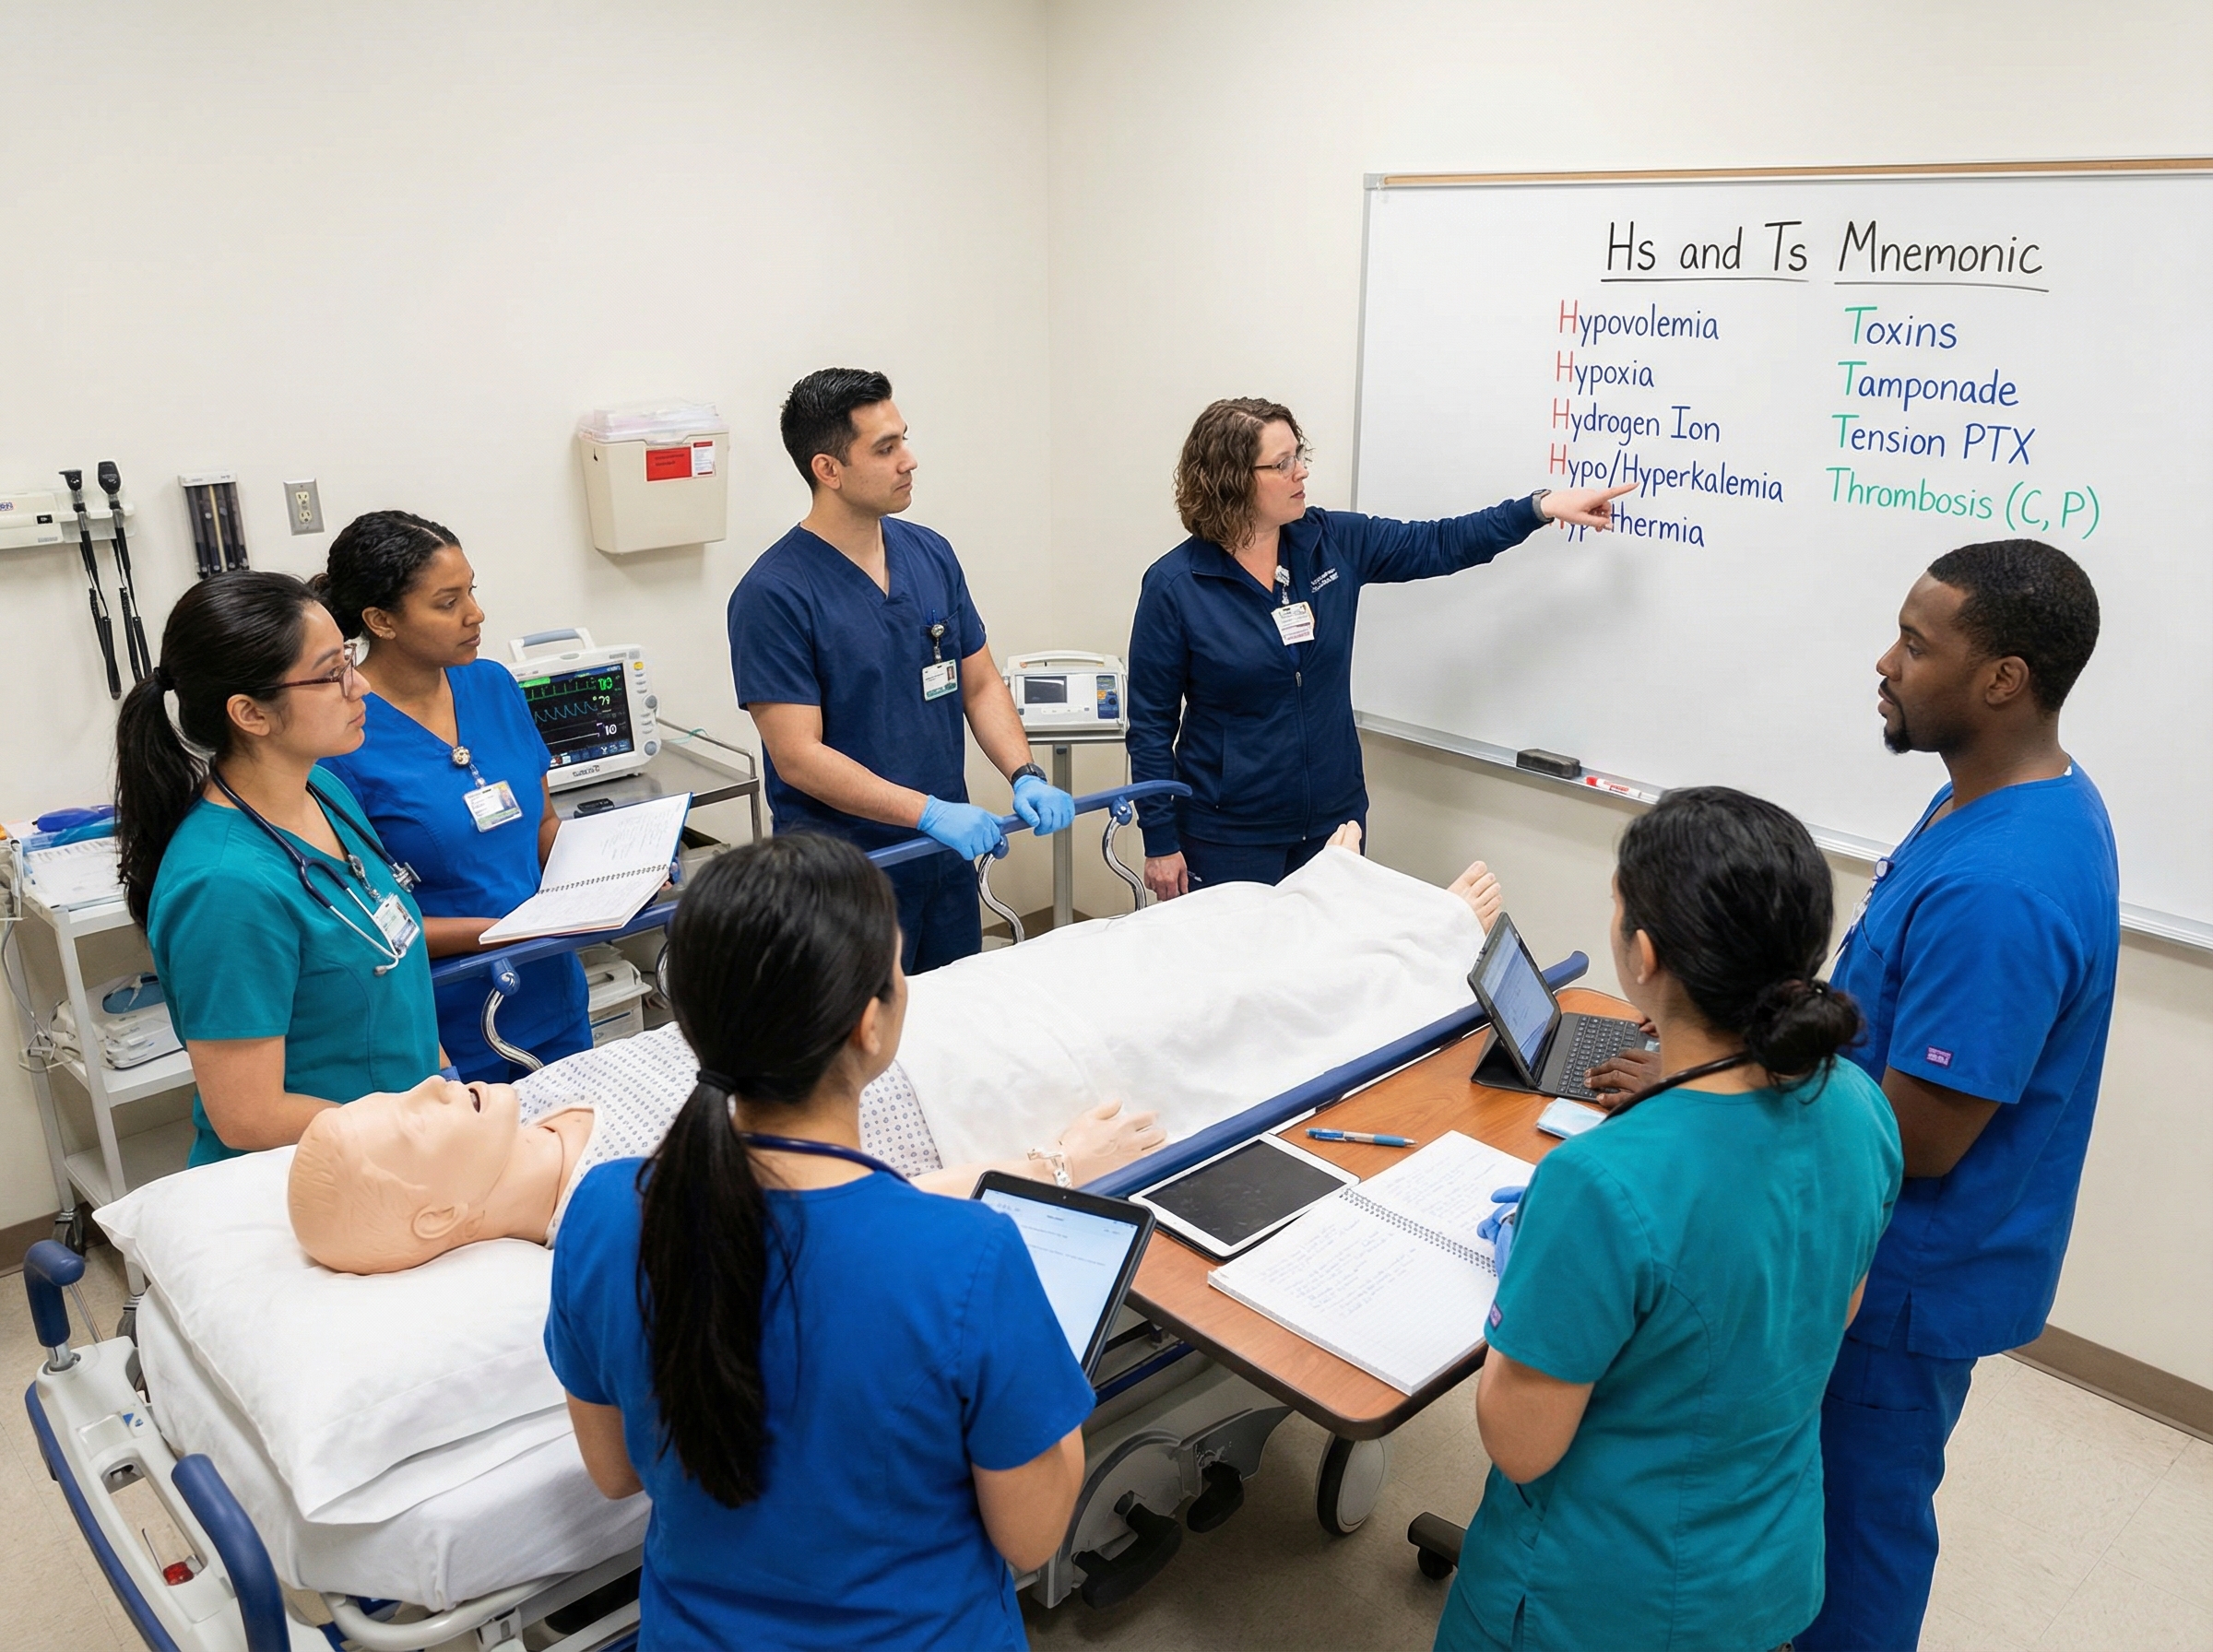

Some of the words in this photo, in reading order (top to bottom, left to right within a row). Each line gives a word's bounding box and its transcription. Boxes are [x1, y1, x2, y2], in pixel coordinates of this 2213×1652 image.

[1607, 221, 1656, 271] Hs
[1679, 226, 1742, 270] and
[1764, 220, 1807, 272] Ts
[1838, 220, 2043, 275] Mnemonic
[1559, 300, 1720, 347] Hypovolemia
[1845, 306, 1958, 349] Toxins
[1556, 350, 1655, 395] Hypoxia
[1838, 361, 2019, 411] Tamponade
[1552, 397, 1660, 446] Hydrogen
[1670, 406, 1721, 443] Ion
[1832, 415, 1946, 457] Tension
[1963, 423, 2036, 466] PTX
[1549, 442, 1784, 503] Hypo/Hyperkalemia
[1826, 467, 1993, 520] Thrombosis
